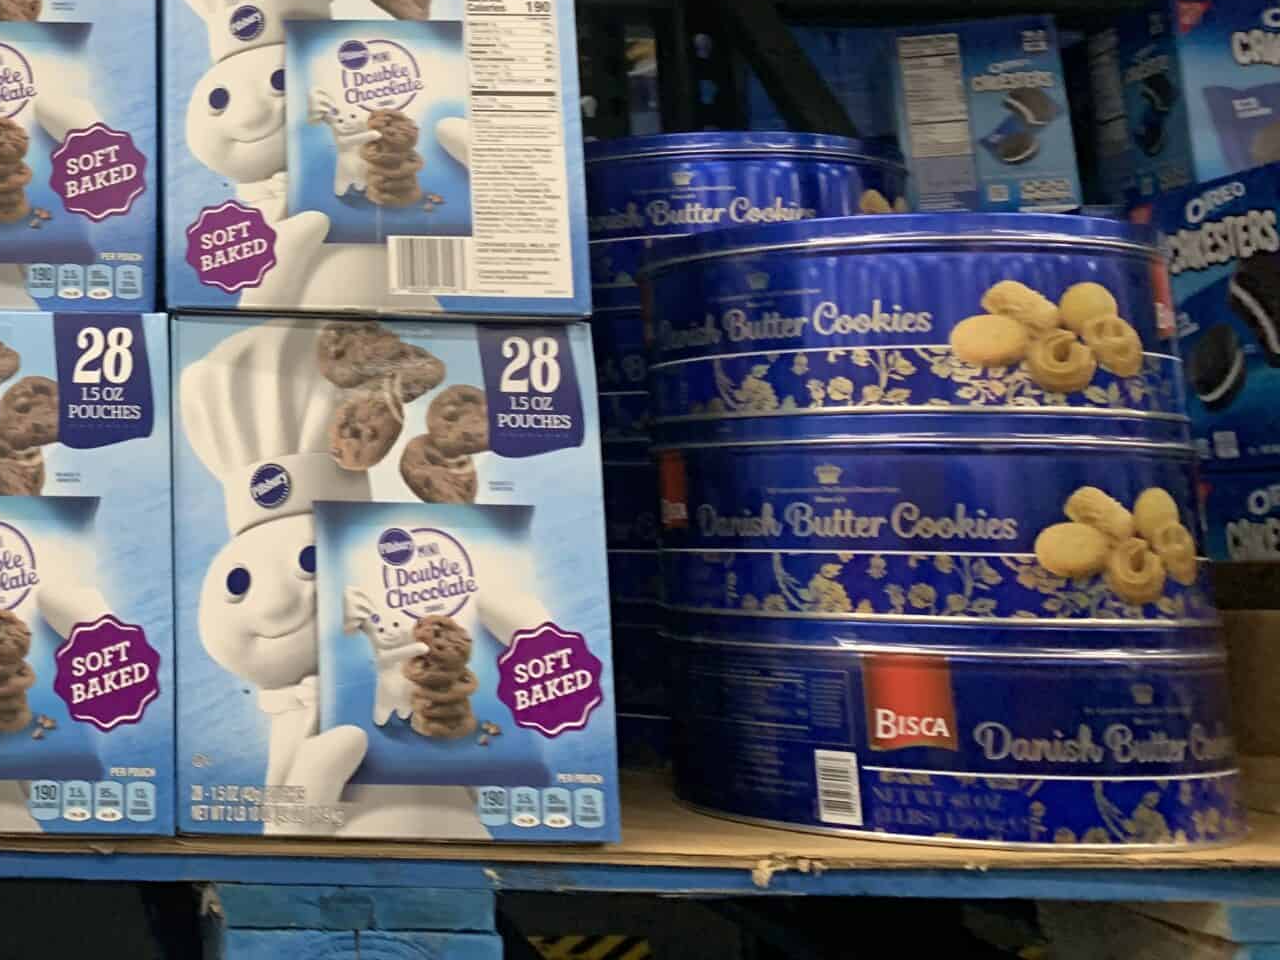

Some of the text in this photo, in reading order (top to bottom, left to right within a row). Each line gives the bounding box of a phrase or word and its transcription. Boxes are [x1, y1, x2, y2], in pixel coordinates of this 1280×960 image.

[525, 1, 550, 13] 190
[344, 77, 424, 106] Chocolate
[352, 64, 410, 92] Double
[66, 145, 120, 176] SOFT
[65, 164, 137, 198] BAKED
[589, 202, 643, 229] nish
[646, 199, 726, 226] Butter
[1185, 181, 1246, 225] OREO
[200, 221, 252, 251] SOFT
[1166, 209, 1280, 276] CAKESTERS
[199, 238, 268, 272] BAKED
[721, 308, 809, 342] Butter
[813, 298, 933, 335] Cookies
[72, 326, 133, 384] 28
[500, 336, 561, 393] 28
[102, 386, 124, 401] OZ
[531, 396, 552, 410] OZ
[68, 403, 142, 420] POUCHES
[497, 413, 572, 430] POUCHES
[696, 501, 1018, 541] Danish Butter Cookies
[396, 558, 462, 587] Double
[385, 575, 479, 610] Chocolate
[71, 641, 130, 678] SOFT
[514, 647, 574, 683] SOFT
[70, 663, 150, 705] BAKED
[514, 669, 593, 710] BAKED
[874, 707, 951, 739] BISCA
[972, 720, 1104, 763] Danish
[1103, 723, 1188, 763] Butter
[34, 785, 57, 800] 190
